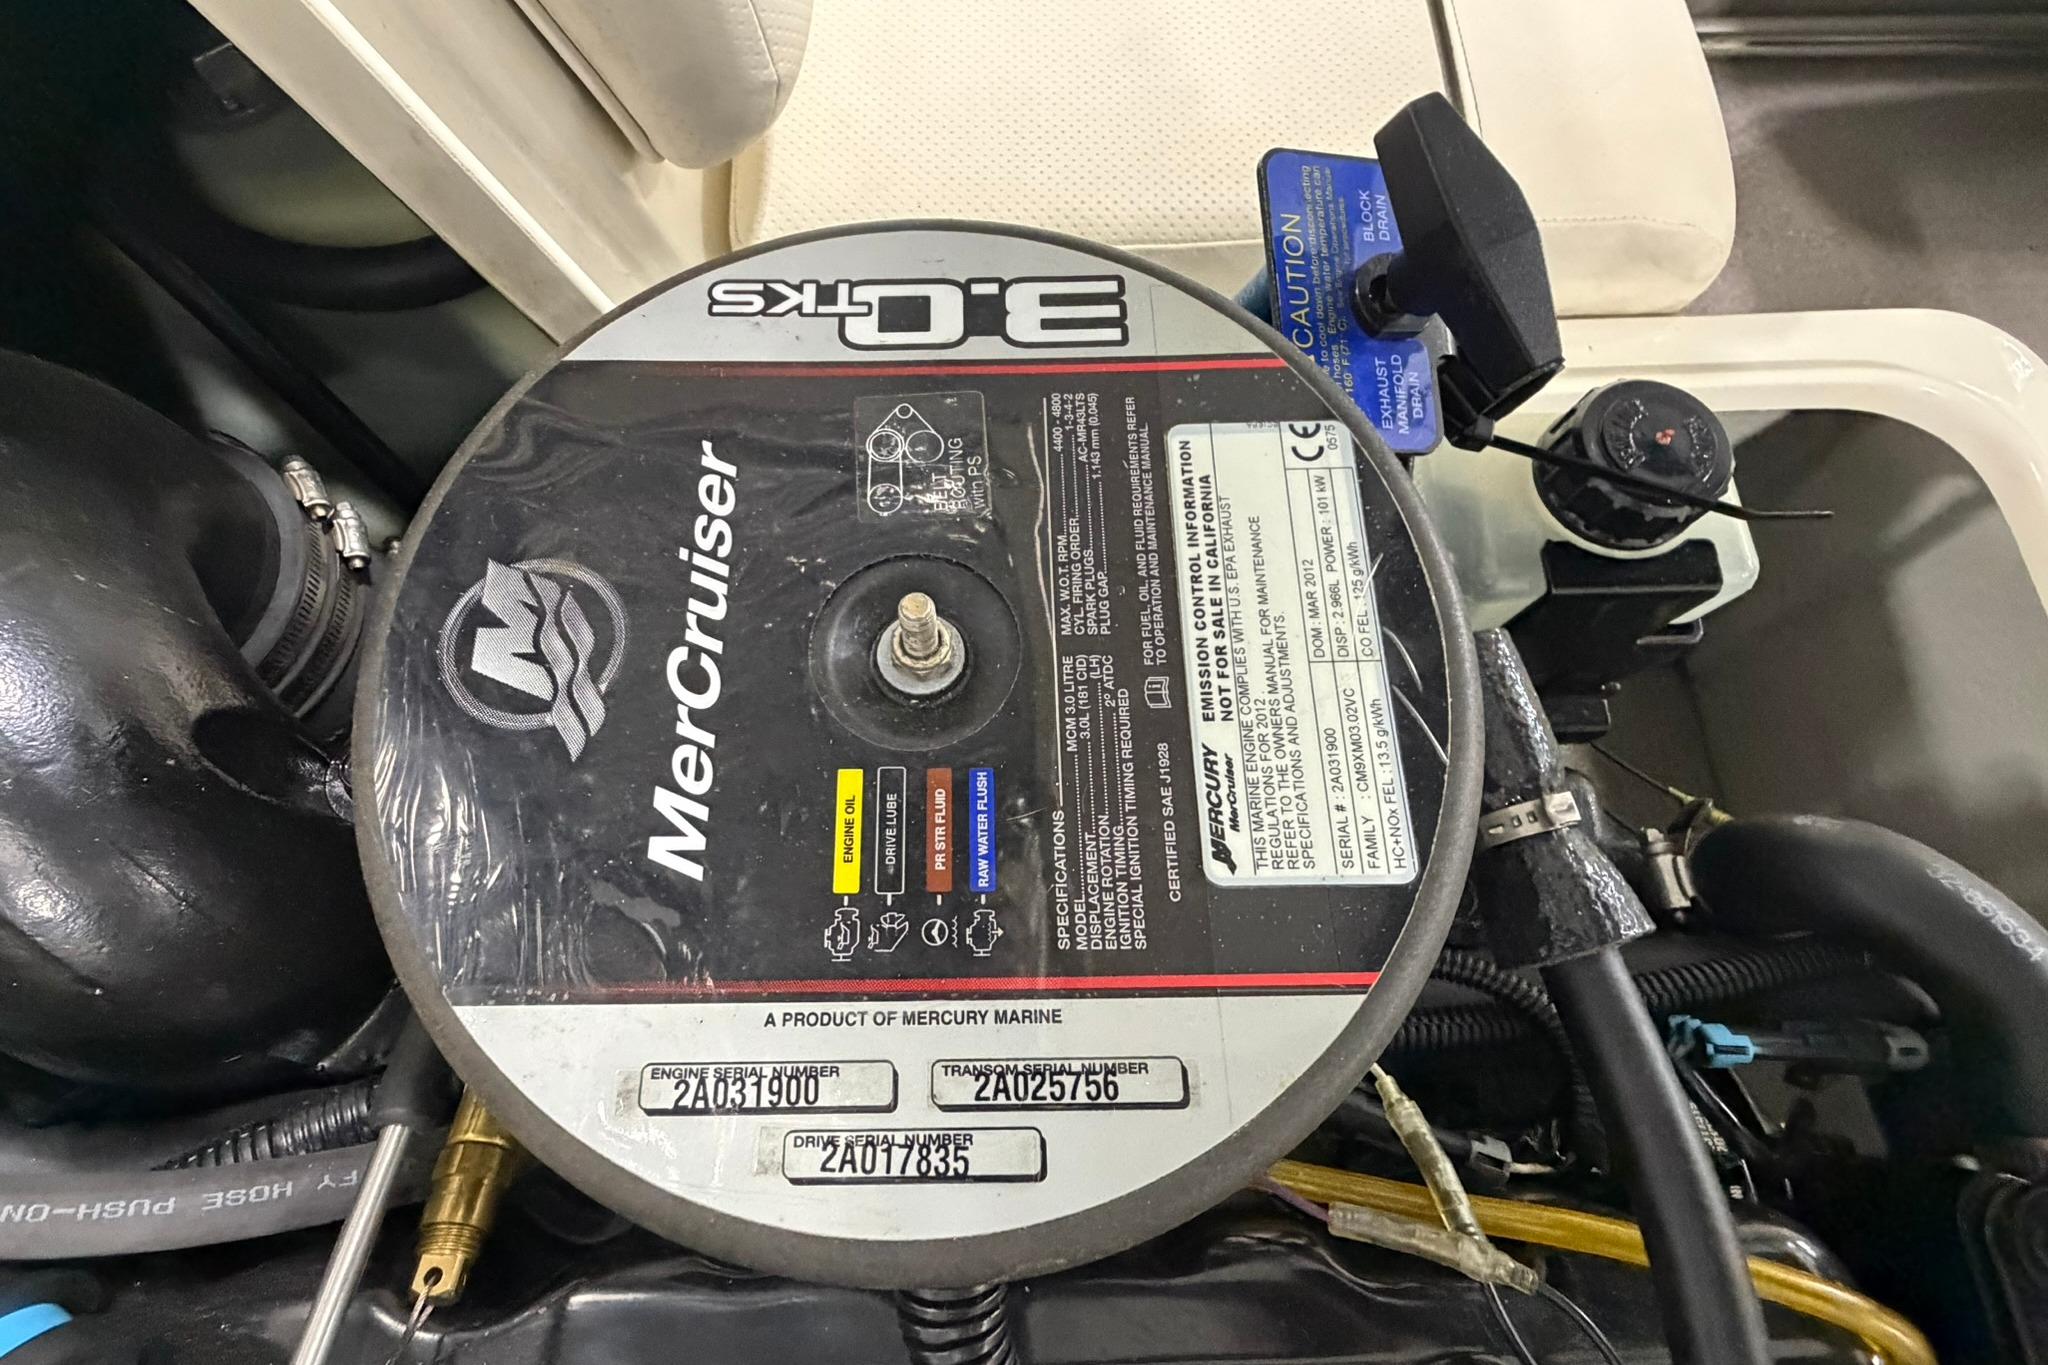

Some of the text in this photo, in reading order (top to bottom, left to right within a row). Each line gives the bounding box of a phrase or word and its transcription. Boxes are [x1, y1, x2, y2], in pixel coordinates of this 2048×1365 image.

[1313, 166, 1323, 185] can
[1315, 189, 1330, 256] temperature
[1359, 190, 1374, 242] BLOCK
[1376, 193, 1390, 241] DRAIN
[1281, 213, 1314, 349] CAUTION
[1309, 248, 1321, 284] before
[709, 275, 1129, 351] 3.0 TKS
[1313, 287, 1324, 316] down
[1051, 393, 1062, 417] 4800
[1087, 392, 1100, 426] (0.045)
[1375, 356, 1394, 429] EXHAUST
[1391, 354, 1409, 434] MANIFOLD
[1408, 371, 1424, 419] DRAIN
[1064, 393, 1074, 431] 1-3-4-2
[1075, 392, 1089, 463] AC-MR43LTS
[1125, 396, 1137, 430] REFER
[1052, 427, 1063, 452] 4400
[1090, 429, 1100, 449] mm
[1326, 424, 1339, 450] 0575
[967, 456, 981, 476] PS
[1091, 451, 1102, 480] 1.143
[1128, 433, 1144, 516] REQUIREMENTS
[1314, 475, 1327, 492] kW
[1316, 495, 1329, 515] 101
[1134, 519, 1147, 551] FLUID
[1136, 553, 1148, 576] AND
[1142, 471, 1167, 665] TO OPERATION AND MAINTENANCE
[1302, 559, 1316, 587] 2012
[1346, 541, 1365, 577] g/kWh
[1058, 565, 1070, 601] W.O.T.
[1070, 562, 1083, 604] FIRING
[1179, 440, 1215, 722] EMISSION CONTROL INFORMATION
[1199, 474, 1234, 722] NOT FOR SALE IN CALIFORNIA
[1331, 579, 1345, 619] 2.966L
[1060, 604, 1073, 635] MAX.
[1085, 592, 1098, 635] SPARK
[1098, 600, 1111, 635] PLUG
[1305, 590, 1321, 619] MAR
[647, 440, 737, 881] MerCruiser
[1143, 640, 1156, 665] FOR
[1360, 637, 1374, 657] CO
[1063, 655, 1075, 693] LITRE
[1076, 654, 1090, 681] CID)
[1089, 654, 1102, 679] (LH)
[1102, 655, 1115, 690] ATDC
[1219, 495, 1269, 870] THIS MARINE ENGINE COMPLIES WITH U.S. EPA EXHAUST
[1064, 696, 1076, 714] 3.0
[1078, 684, 1091, 709] (181
[1248, 515, 1300, 870] REFER TO THE OWNERS MANUAL FOR MAINTENANCE
[1065, 717, 1078, 752] MCM
[1080, 713, 1091, 739] 3.0L
[1284, 716, 1299, 746] AND
[1369, 698, 1389, 738] g/kWh
[1258, 732, 1272, 761] FOR
[1376, 740, 1392, 767] 13.5
[1202, 742, 1237, 875] MERCURY
[1225, 753, 1240, 832] MerCruiser
[1290, 749, 1316, 870] SPECIFICATIONS
[1324, 727, 1355, 869] SERIAL 2A031900
[841, 794, 857, 864] ENGINE OIL
[884, 792, 898, 865] DRIVE LUBE
[933, 788, 947, 871] PR STR FLUID
[975, 771, 990, 888] RAW WATER FLUSH
[1118, 688, 1147, 949] SPECIAL IGNITION TIMING REQUIRED
[1158, 742, 1182, 902] CERTIFIED SAE J1928
[1259, 766, 1284, 870] REGULATIONS
[1361, 815, 1381, 869] FAMILY
[1387, 808, 1407, 869] HC+NOx
[1052, 810, 1071, 950] SPECIFICATIONS
[1100, 892, 1117, 950] ENGINE
[1117, 882, 1132, 950] IGNITION
[764, 1009, 1063, 1028] A PRODUCT OF MERCURY MARINE
[651, 1066, 840, 1080] ENGINE SERIAL NUMBER
[974, 1071, 1119, 1102] 2A025756
[672, 1076, 819, 1109] 2A031900
[793, 1135, 840, 1148] DRIVE
[905, 1134, 973, 1146] NUMBER
[820, 1141, 969, 1177] 2A017835
[200, 1180, 293, 1210] HOSE
